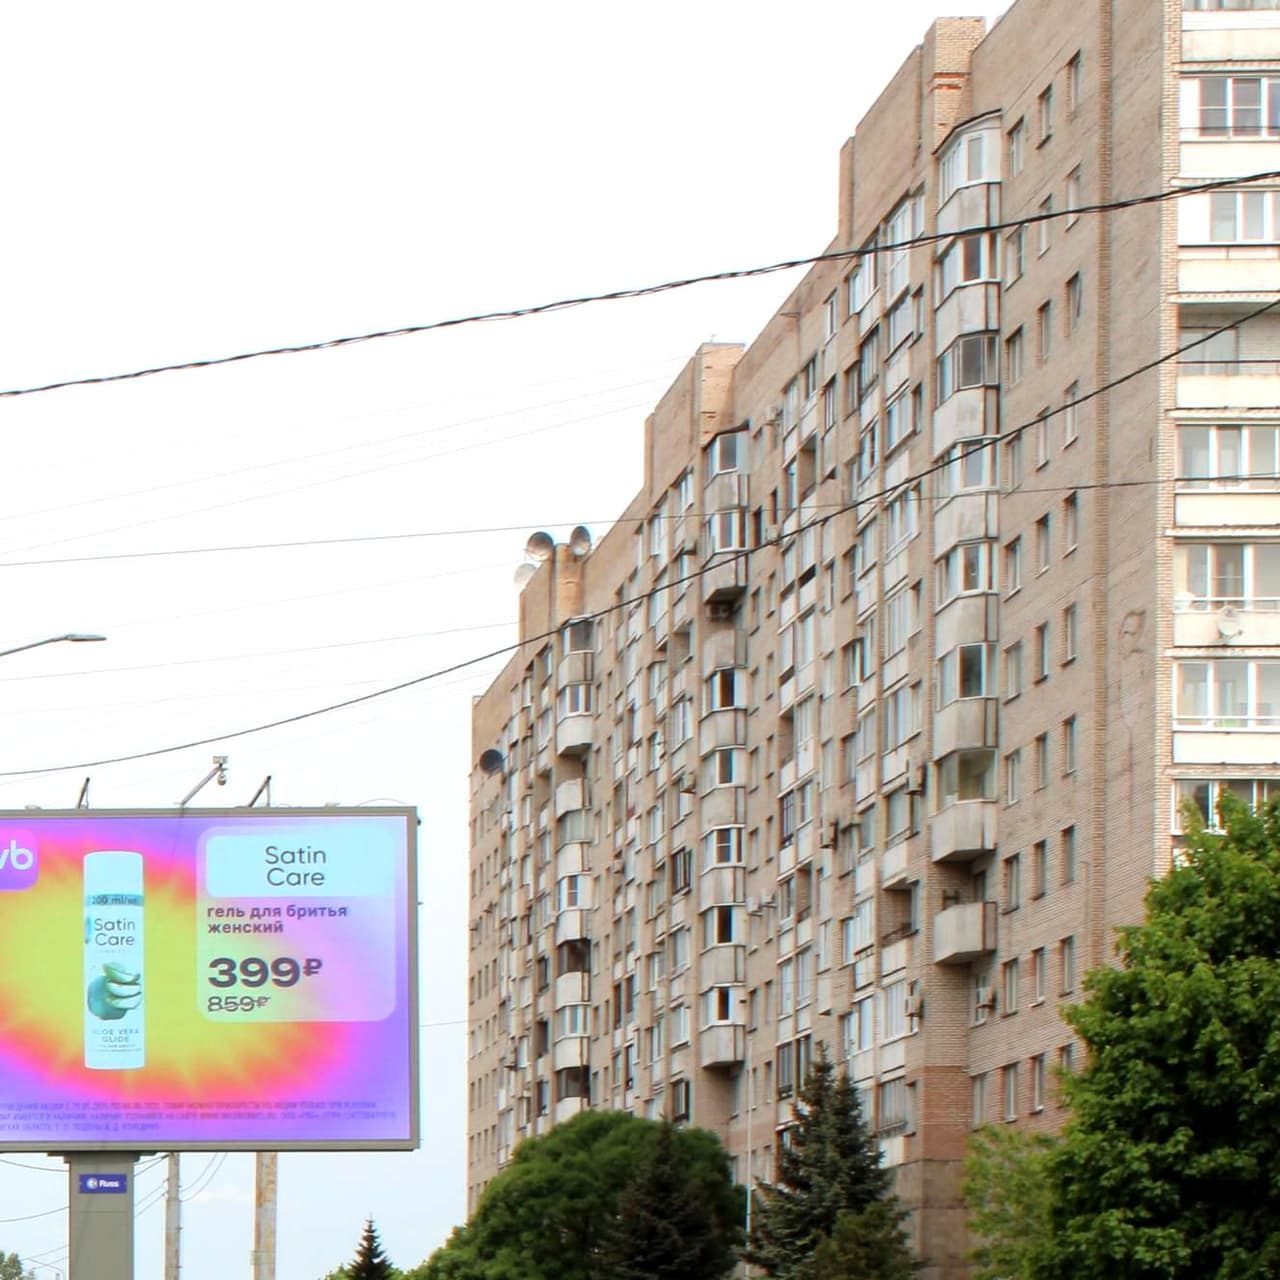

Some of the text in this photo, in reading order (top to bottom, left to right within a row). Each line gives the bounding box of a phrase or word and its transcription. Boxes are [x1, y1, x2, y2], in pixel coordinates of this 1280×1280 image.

[265, 845, 326, 865] Satin
[267, 867, 325, 886] Care
[207, 904, 348, 920] гель для бритья
[94, 917, 136, 931] Satin
[207, 920, 284, 934] женский
[95, 932, 136, 946] Care
